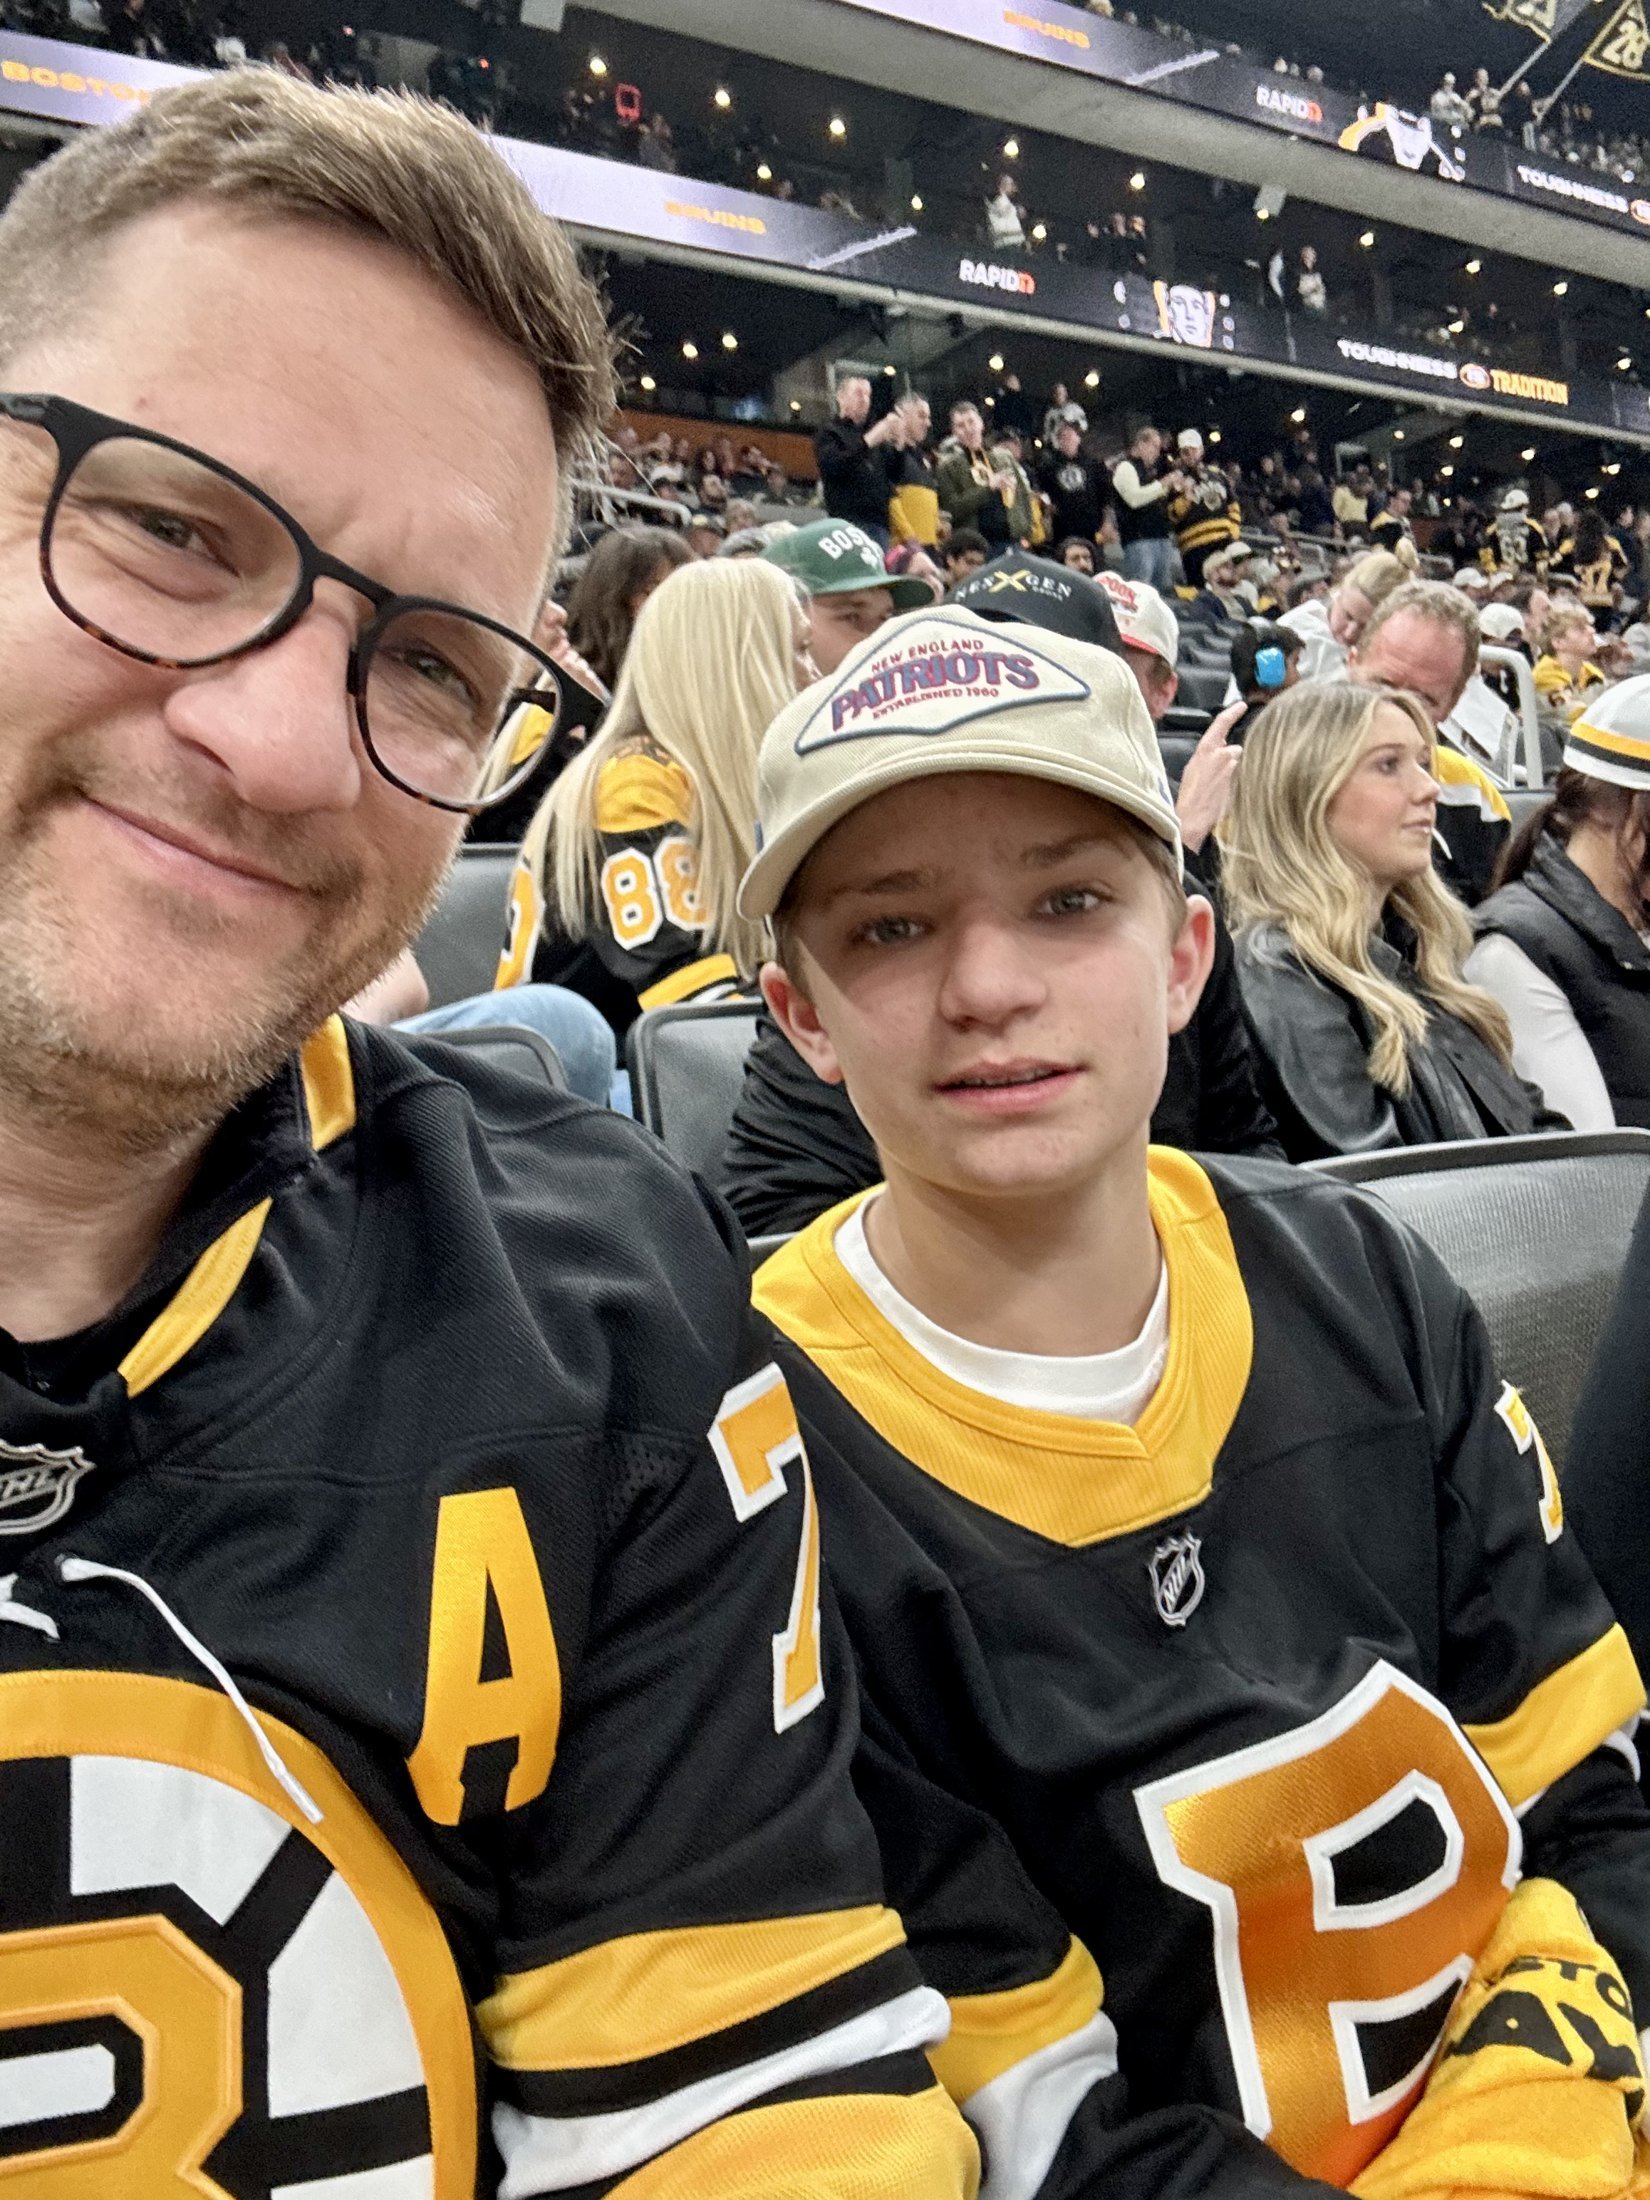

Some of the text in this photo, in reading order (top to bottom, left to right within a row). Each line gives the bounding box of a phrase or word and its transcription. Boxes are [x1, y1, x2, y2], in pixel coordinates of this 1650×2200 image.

[1490, 369, 1568, 405] TRADITION
[831, 651, 1040, 732] PATRIOTS
[871, 639, 984, 673] NEW ENGLAND
[872, 688, 963, 720] ESTABLISHED
[601, 836, 718, 951] 88
[707, 1362, 825, 1735] 7
[406, 1487, 562, 1826] A
[1132, 1658, 1523, 2188] B
